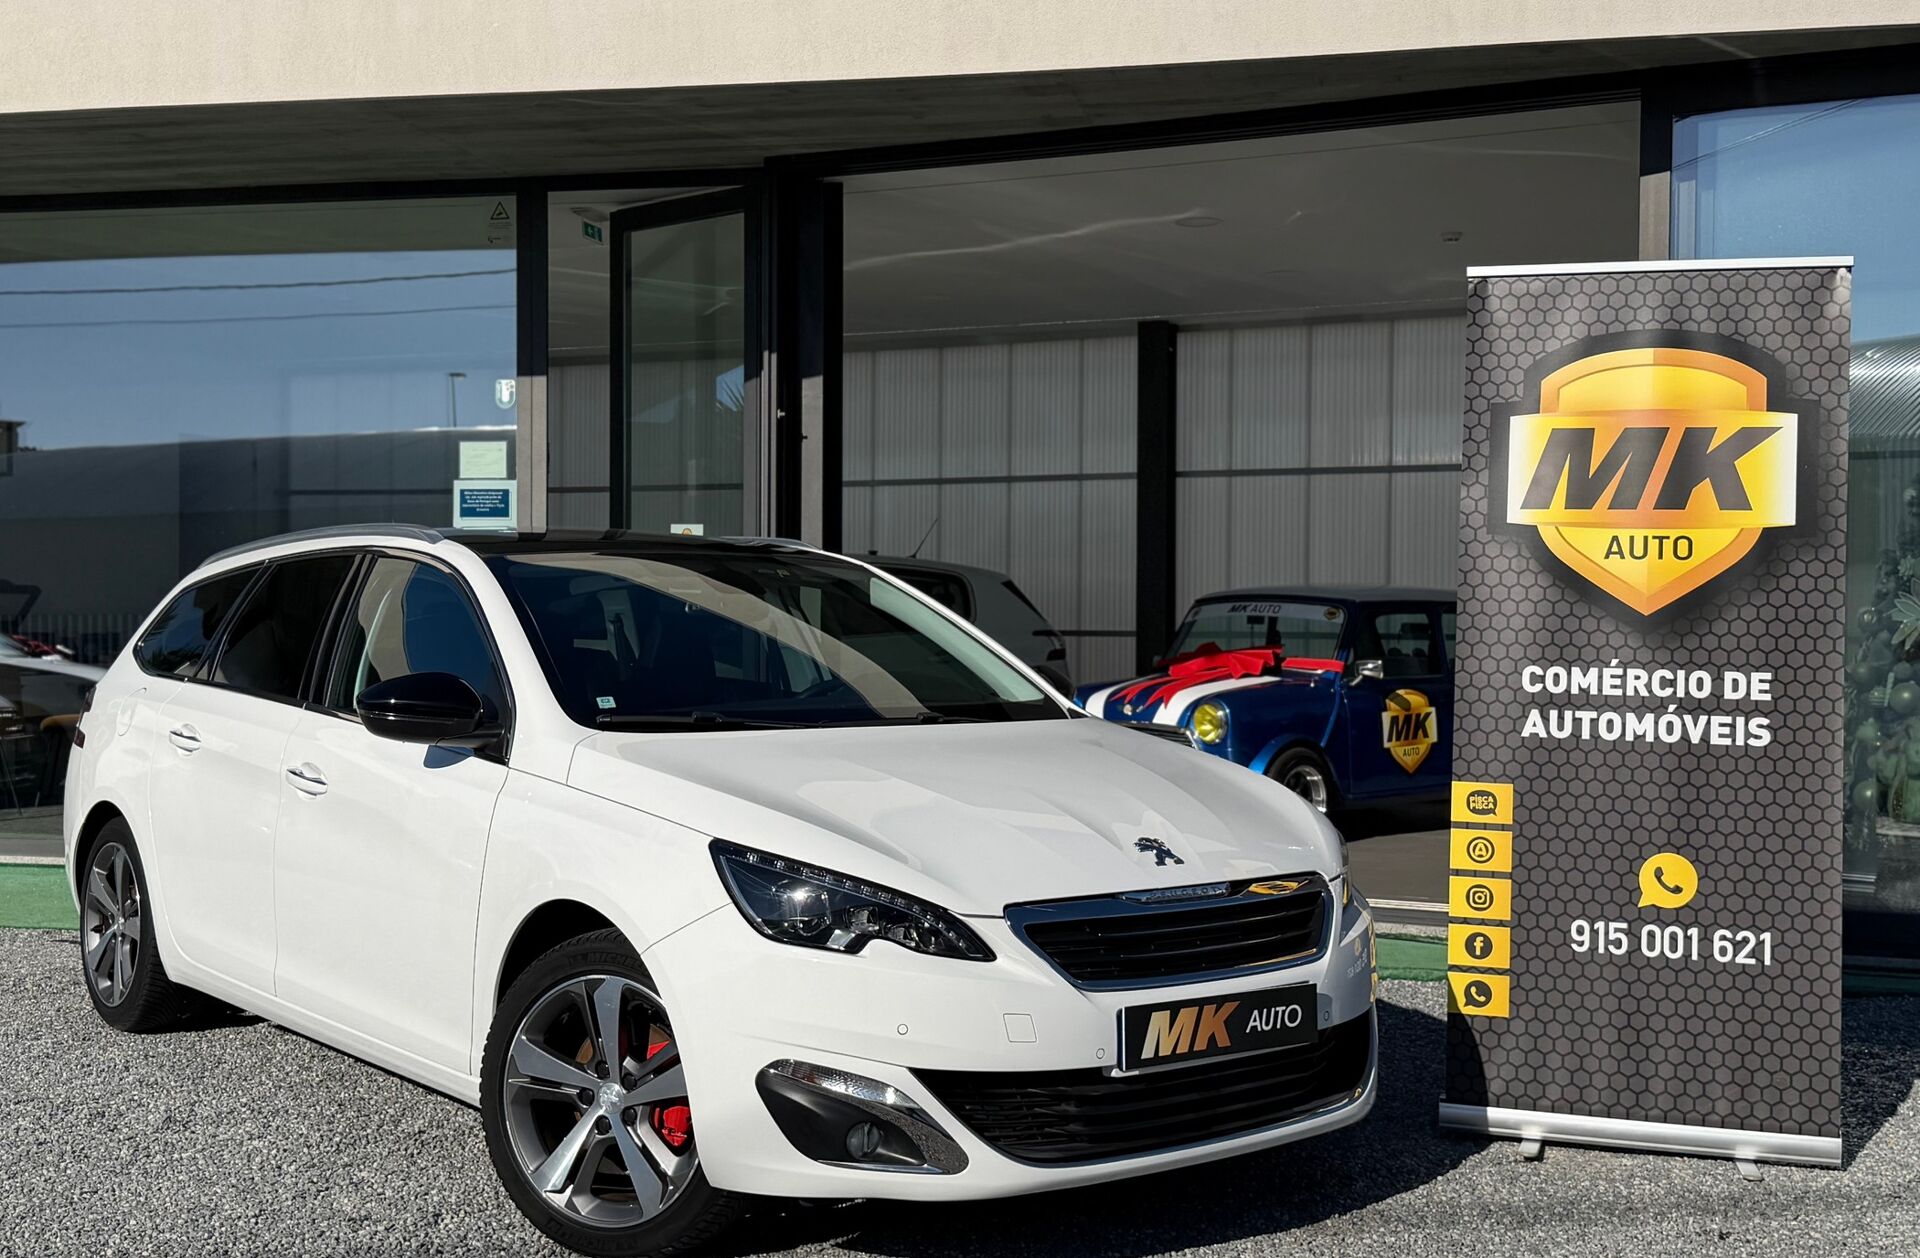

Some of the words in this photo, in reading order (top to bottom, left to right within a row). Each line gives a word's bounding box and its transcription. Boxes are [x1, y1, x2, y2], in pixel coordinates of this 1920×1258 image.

[1520, 426, 1784, 511] MK
[1603, 535, 1694, 561] AUTO
[1228, 604, 1250, 613] MK
[1251, 604, 1281, 614] AUTO
[1521, 659, 1713, 700] COMÉRCIO
[1724, 670, 1772, 701] DE
[1387, 711, 1433, 743] MK
[1520, 705, 1772, 747] AUTOMÓVEIS
[1402, 747, 1420, 757] AUTO
[1570, 920, 1628, 956] 915
[1640, 925, 1698, 960] 001
[1713, 929, 1772, 966] 621
[1141, 1001, 1241, 1060] MK
[1246, 1003, 1302, 1034] AUTO
